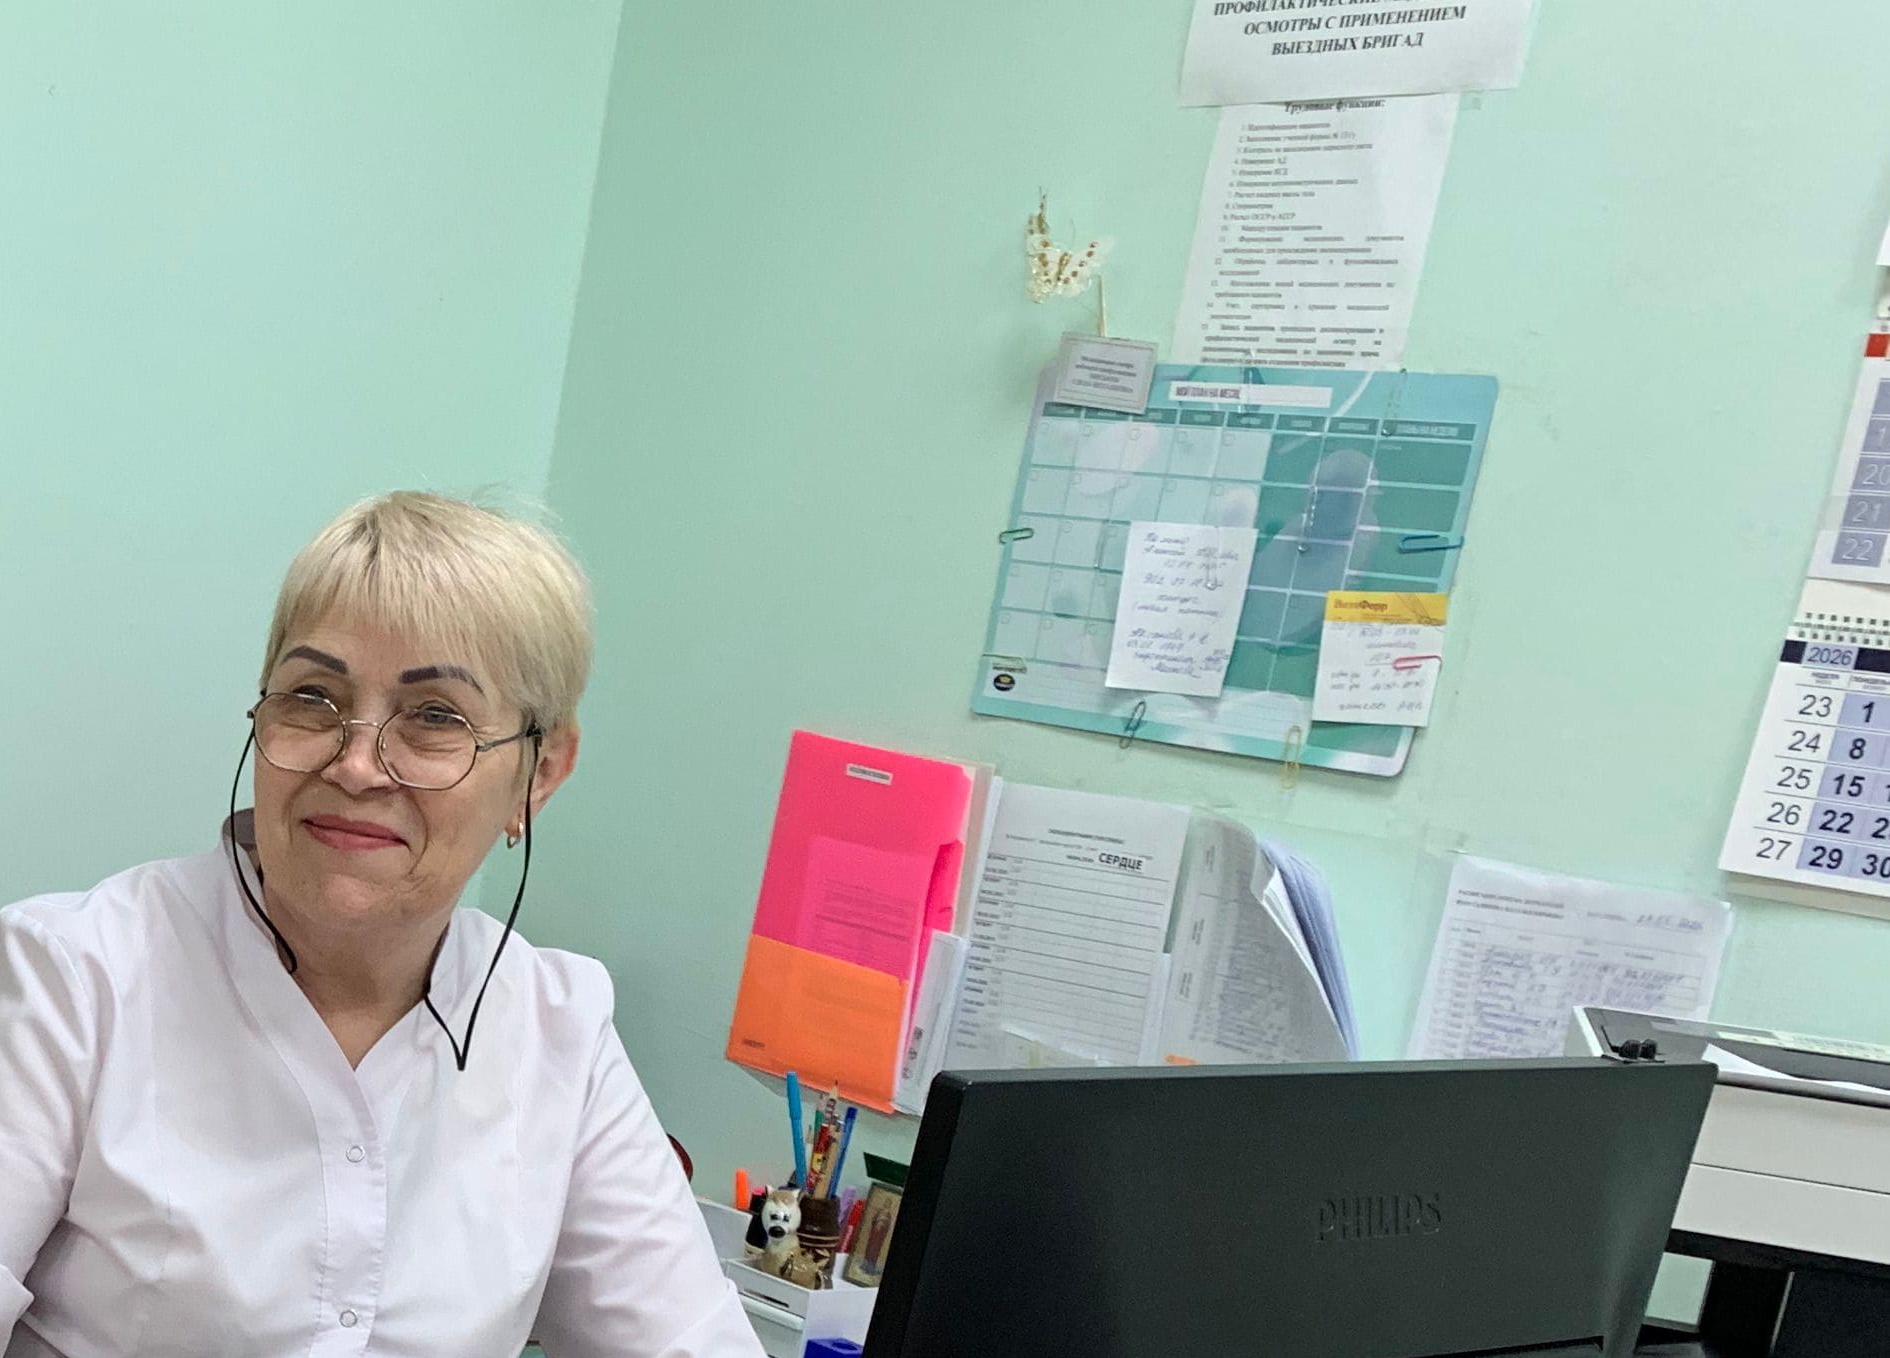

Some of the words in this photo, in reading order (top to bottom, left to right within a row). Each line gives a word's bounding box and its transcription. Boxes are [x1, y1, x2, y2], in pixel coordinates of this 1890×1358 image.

[1244, 17, 1322, 35] ОСМОТРЫ
[1325, 16, 1337, 29] С
[1339, 6, 1466, 28] ПРИМЕНЕНИЕМ
[1272, 37, 1360, 55] ВЫЕЗДНЫХ
[1362, 32, 1424, 49] БРИГАД
[1852, 501, 1883, 523] 21
[1842, 538, 1874, 561] 22
[1807, 646, 1853, 666] 2026
[1799, 694, 1832, 718] 23
[1862, 702, 1875, 723] 1
[1788, 730, 1821, 753] 24
[1849, 738, 1866, 760] 8
[1777, 766, 1813, 790] 25
[1833, 774, 1865, 797] 15
[1767, 802, 1802, 826] 26
[1819, 809, 1854, 834] 22
[1098, 852, 1143, 871] СЕРДЦЕ
[1756, 837, 1792, 861] 27
[1809, 846, 1843, 870] 29
[1319, 1193, 1442, 1242] PHILIPS
